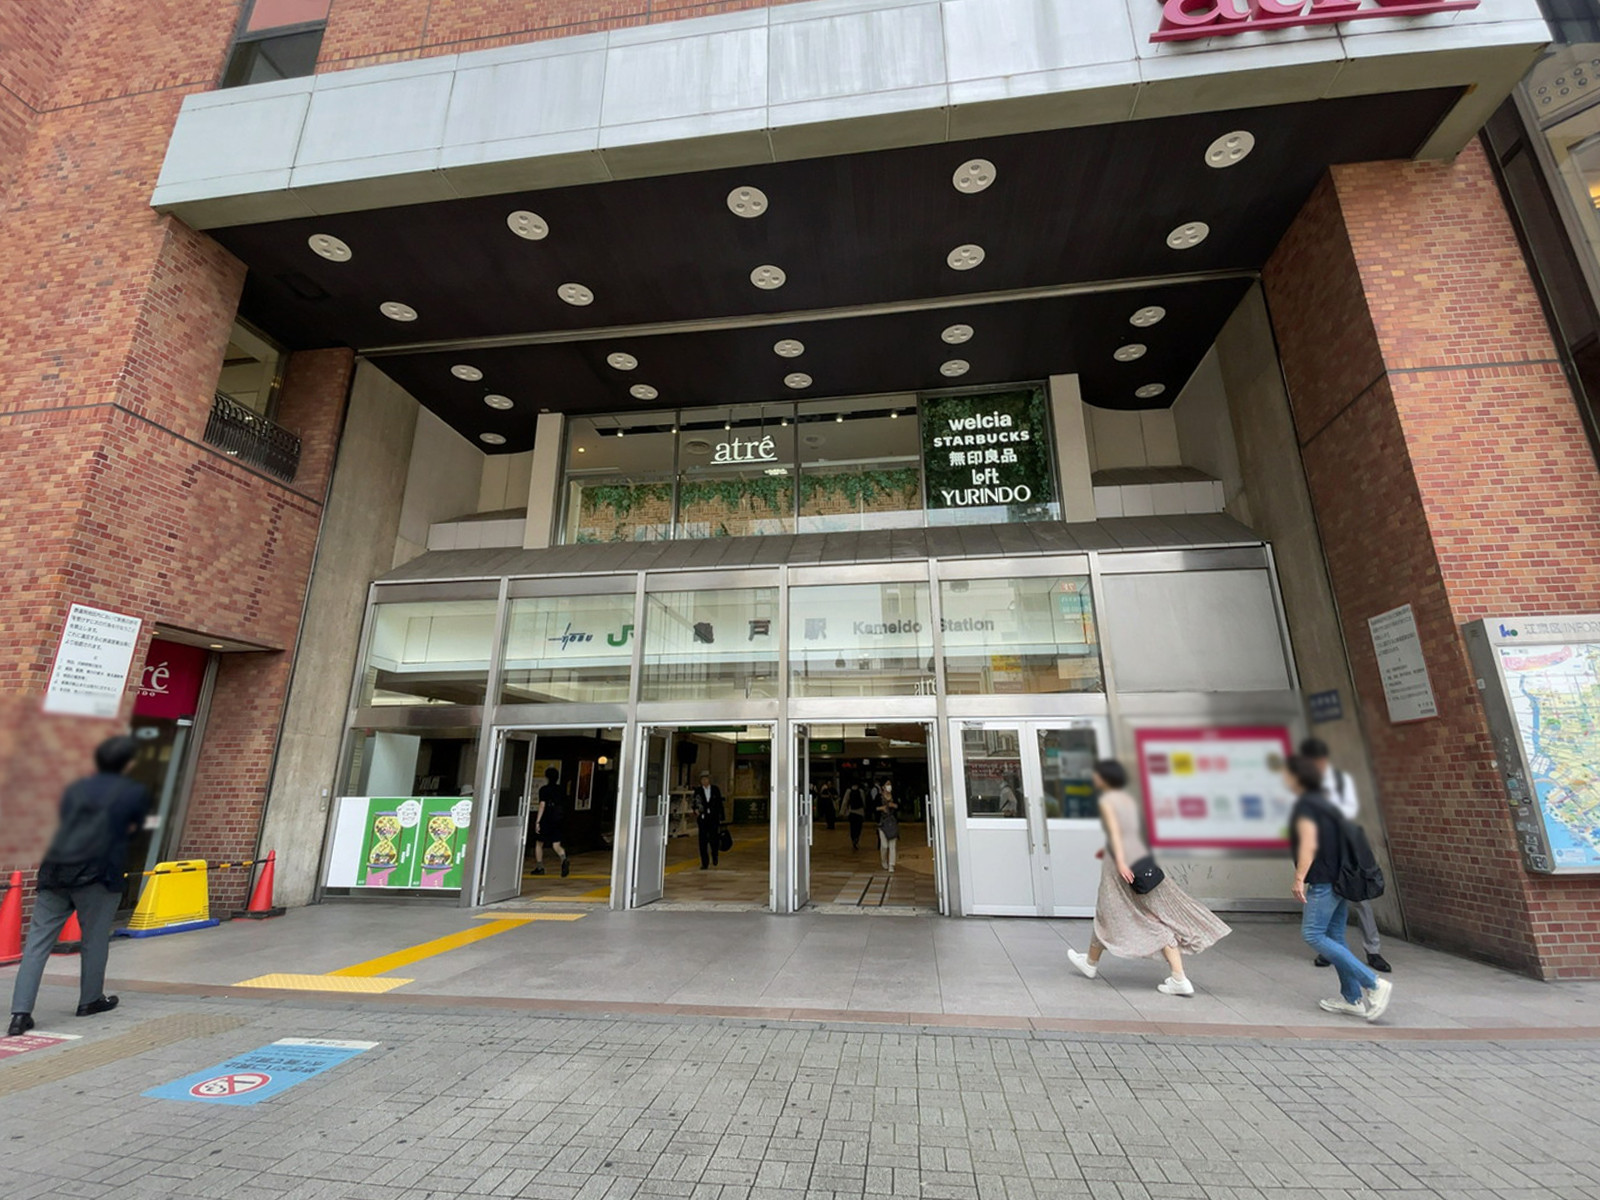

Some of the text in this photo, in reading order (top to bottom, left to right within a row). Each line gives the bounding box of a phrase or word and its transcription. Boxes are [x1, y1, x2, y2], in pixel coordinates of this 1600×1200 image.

[948, 411, 1013, 432] welcia
[714, 434, 776, 462] atré
[933, 430, 1031, 448] STARBUCKS
[949, 448, 1018, 467] 無印良品
[941, 484, 1032, 506] YURINDO
[853, 617, 994, 636] Kameido Station
